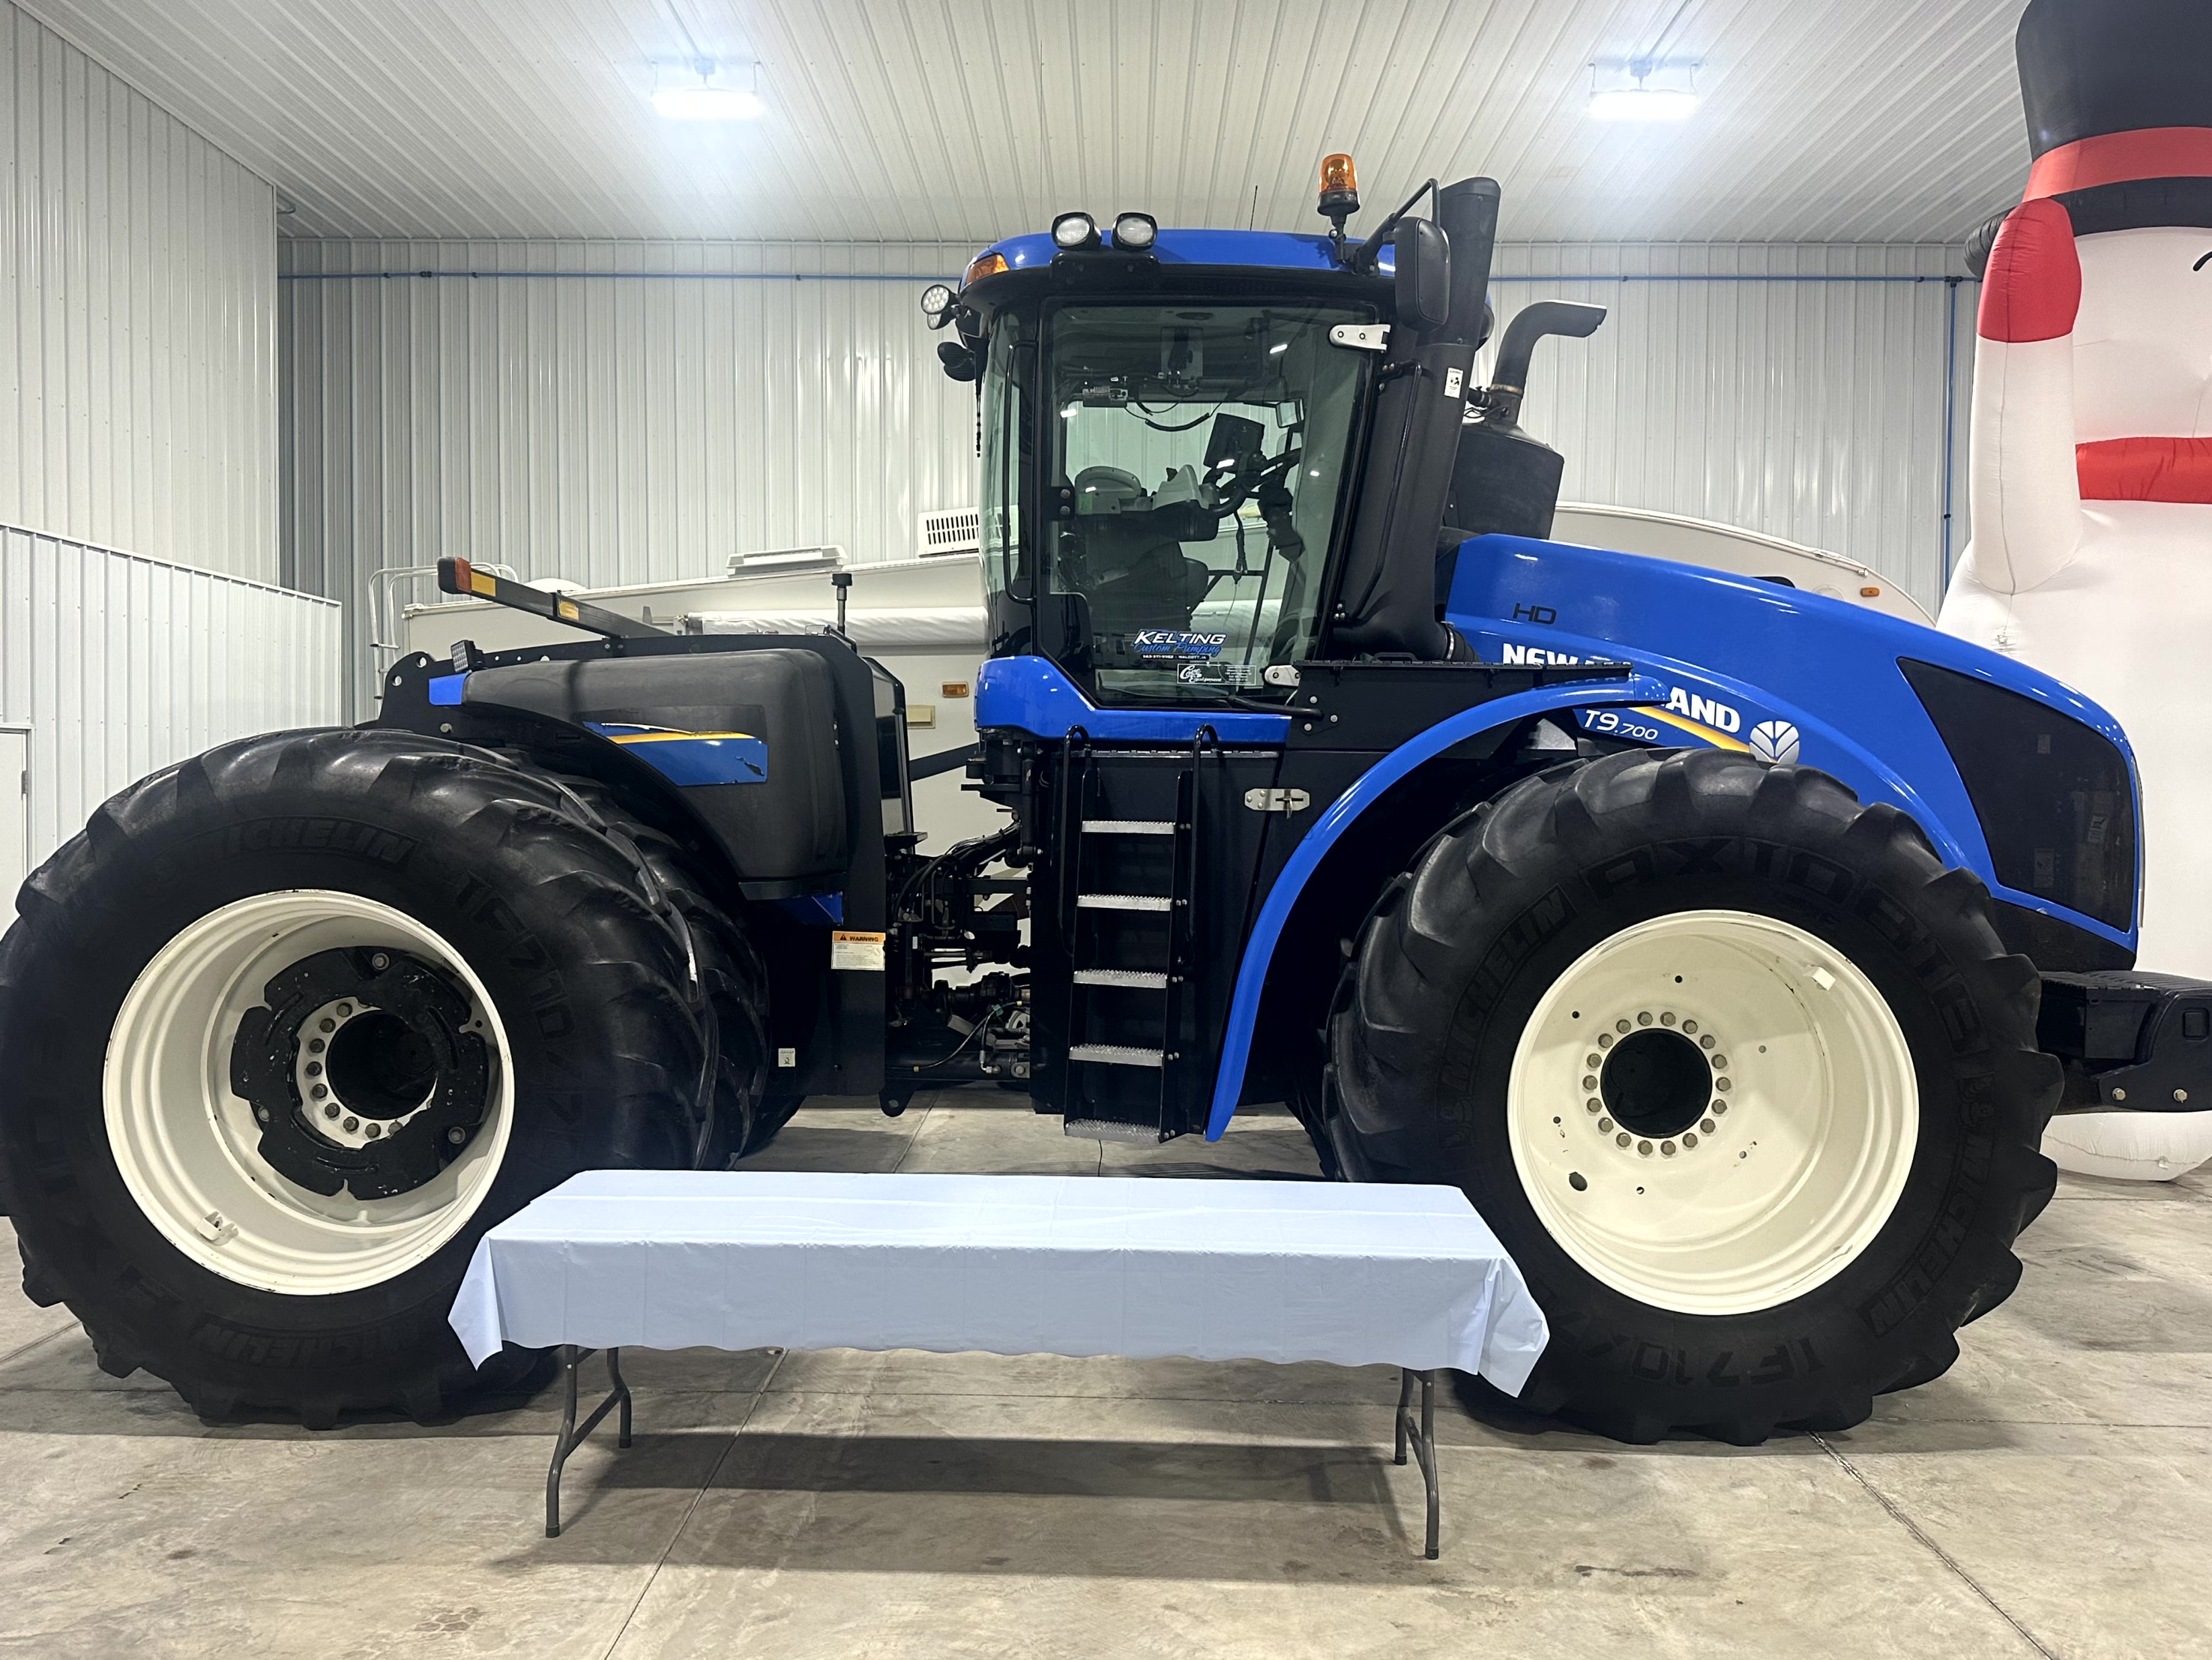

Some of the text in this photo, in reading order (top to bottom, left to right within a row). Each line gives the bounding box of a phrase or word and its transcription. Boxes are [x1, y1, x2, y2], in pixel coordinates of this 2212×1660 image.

[1513, 603, 1557, 625] HD
[1134, 631, 1227, 646] KELTING
[1133, 643, 1222, 657] Custom Pumping
[1439, 888, 1568, 1094] MICHELIN
[1866, 1133, 1993, 1335] MICHELIN
